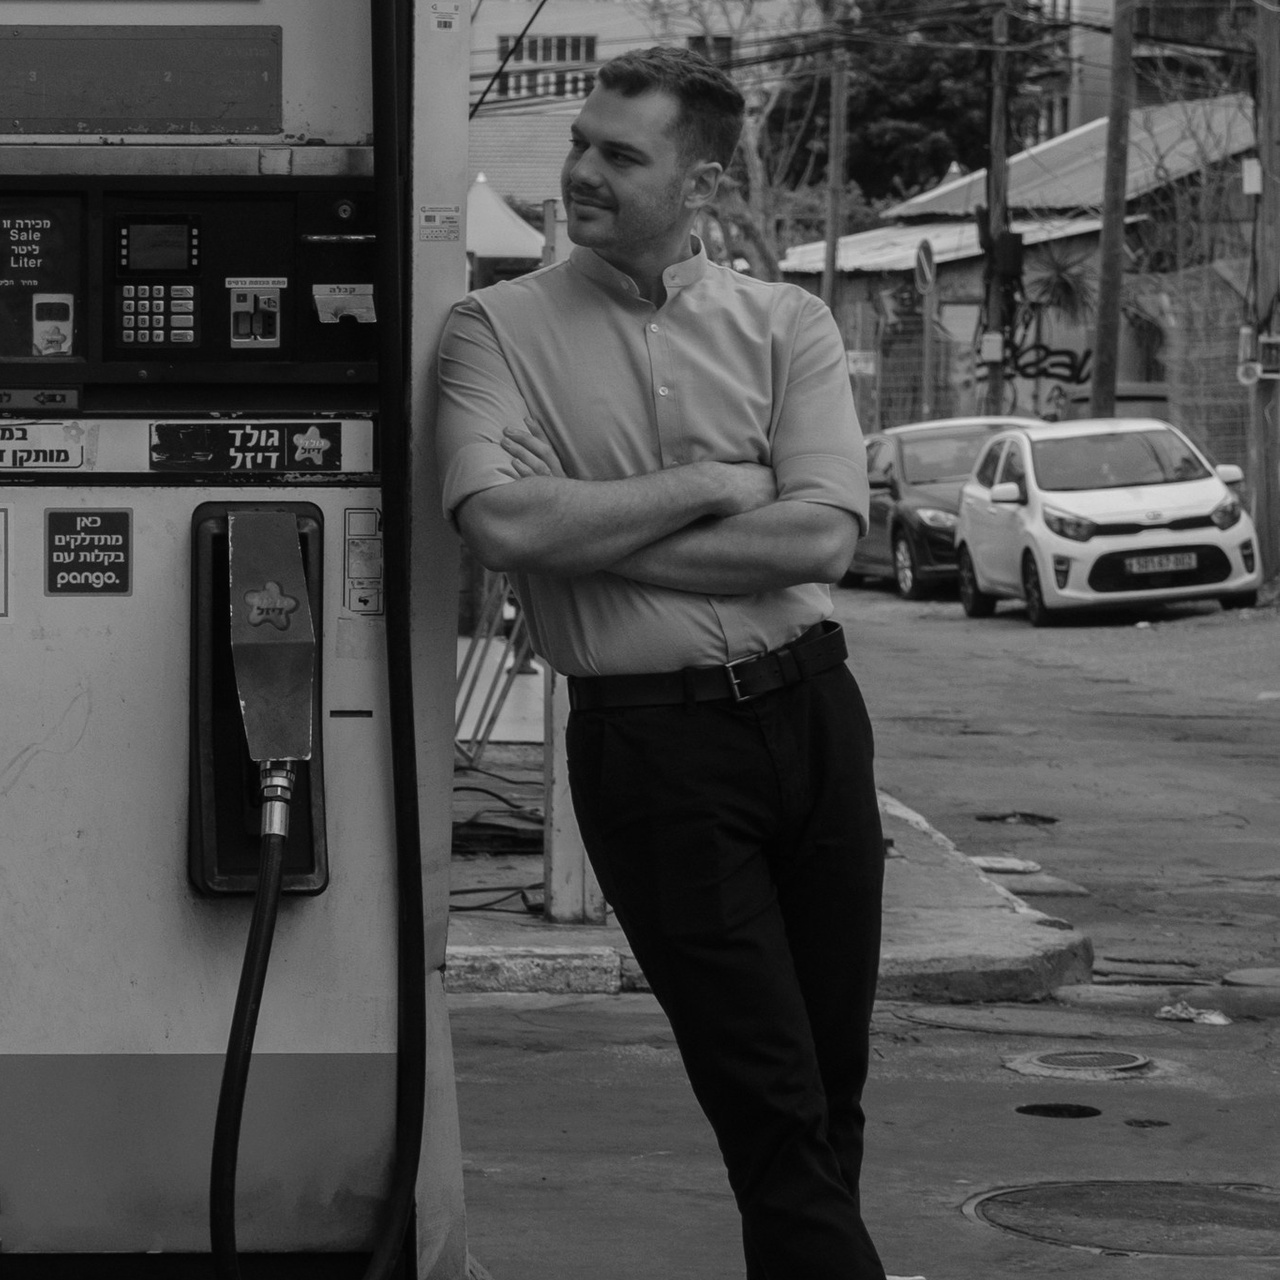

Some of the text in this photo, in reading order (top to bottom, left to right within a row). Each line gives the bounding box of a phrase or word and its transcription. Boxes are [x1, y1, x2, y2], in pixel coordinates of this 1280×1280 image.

[1, 219, 51, 229] מכירה זו
[9, 229, 41, 241] Sale
[10, 244, 40, 255] ליטר
[10, 256, 43, 268] Liter
[329, 285, 356, 294] קבלה
[228, 424, 280, 447] גולד
[11, 448, 70, 468] מותקן
[229, 447, 280, 469] דיזל
[76, 516, 102, 532] כאן
[54, 533, 124, 549] מתדלקים
[52, 550, 125, 565] בקלות עם
